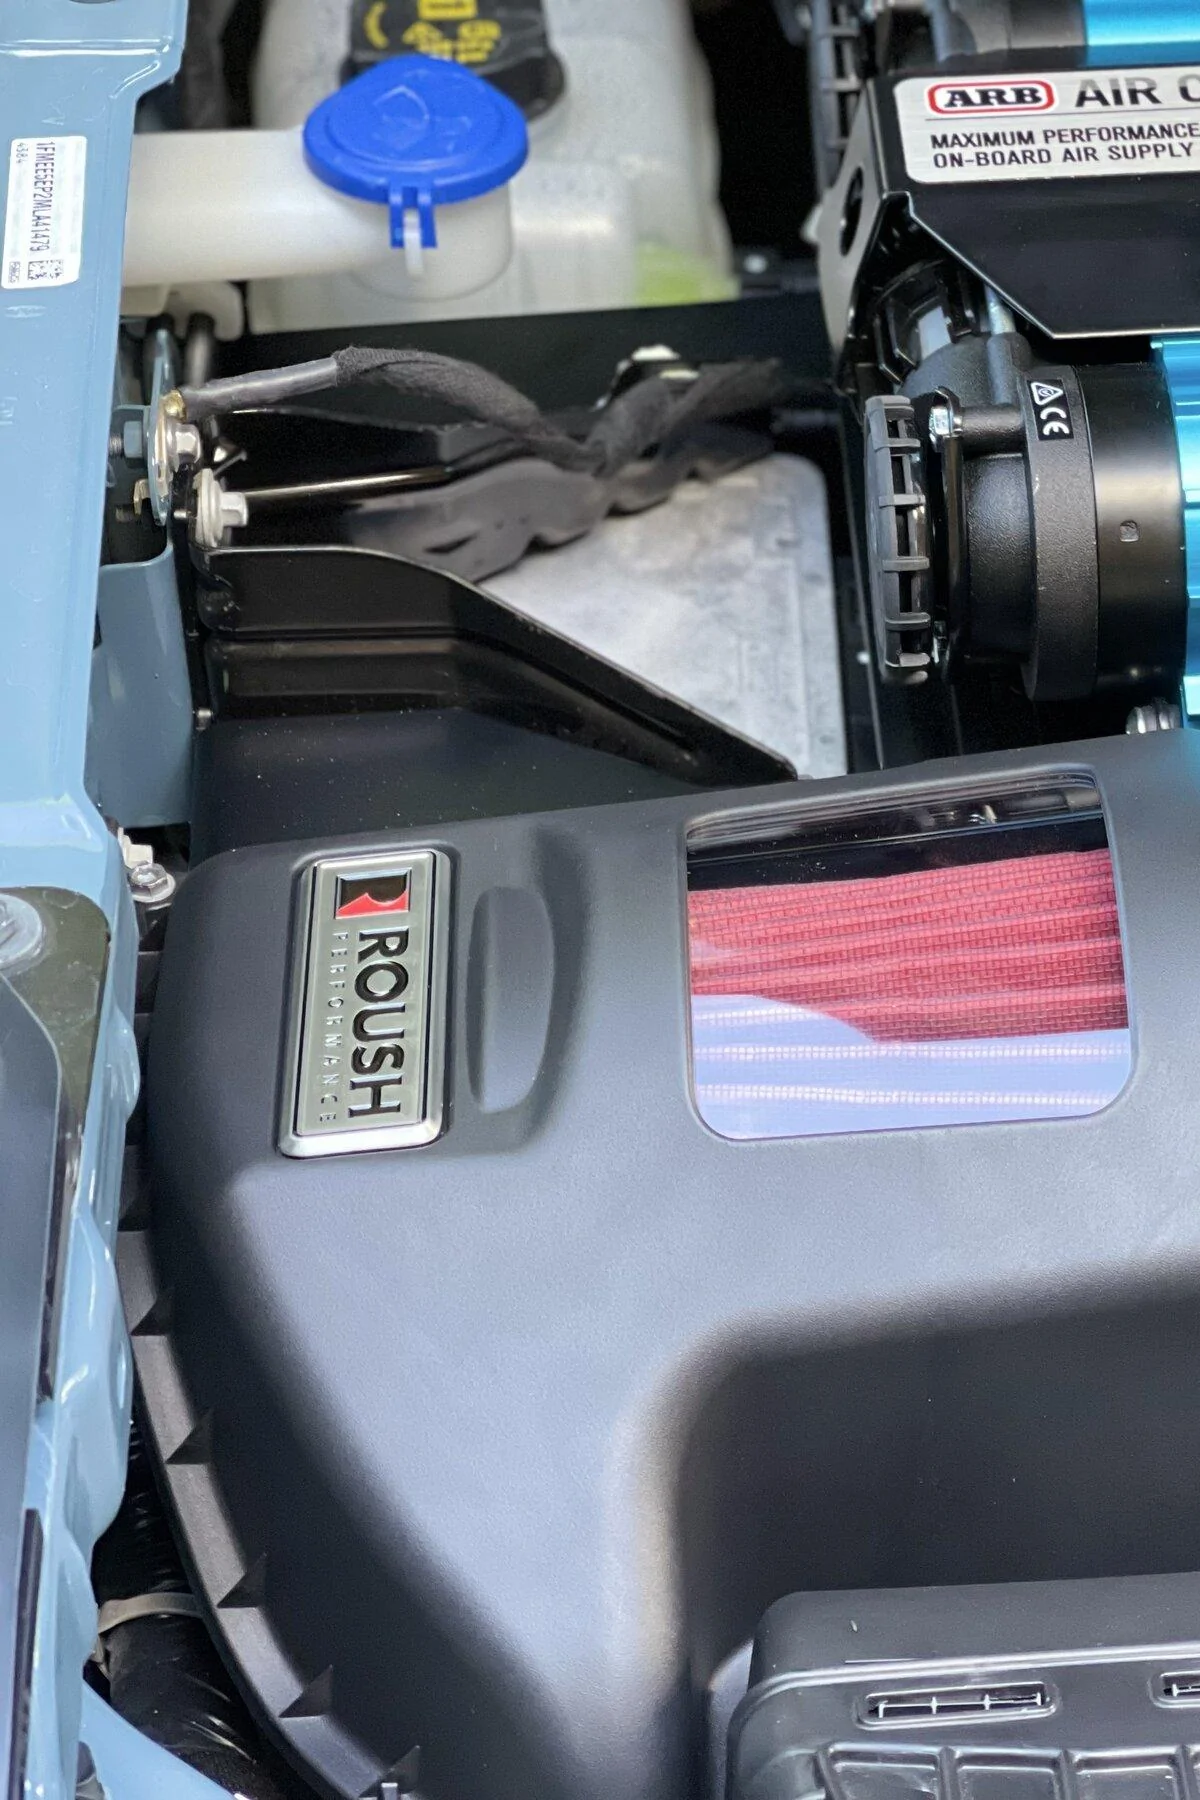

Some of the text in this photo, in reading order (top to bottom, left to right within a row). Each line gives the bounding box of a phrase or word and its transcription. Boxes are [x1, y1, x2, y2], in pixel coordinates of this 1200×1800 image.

[943, 86, 1043, 109] ARB
[1074, 76, 1162, 108] AIR
[931, 131, 1035, 149] MAXIMUM
[933, 142, 1194, 168] ON-BOARD AIR SUPPLY
[29, 141, 56, 253] 1FMEE5EP2MLA41479
[319, 930, 349, 1122] PERFORMANCE
[348, 926, 410, 1118] ROUSH
